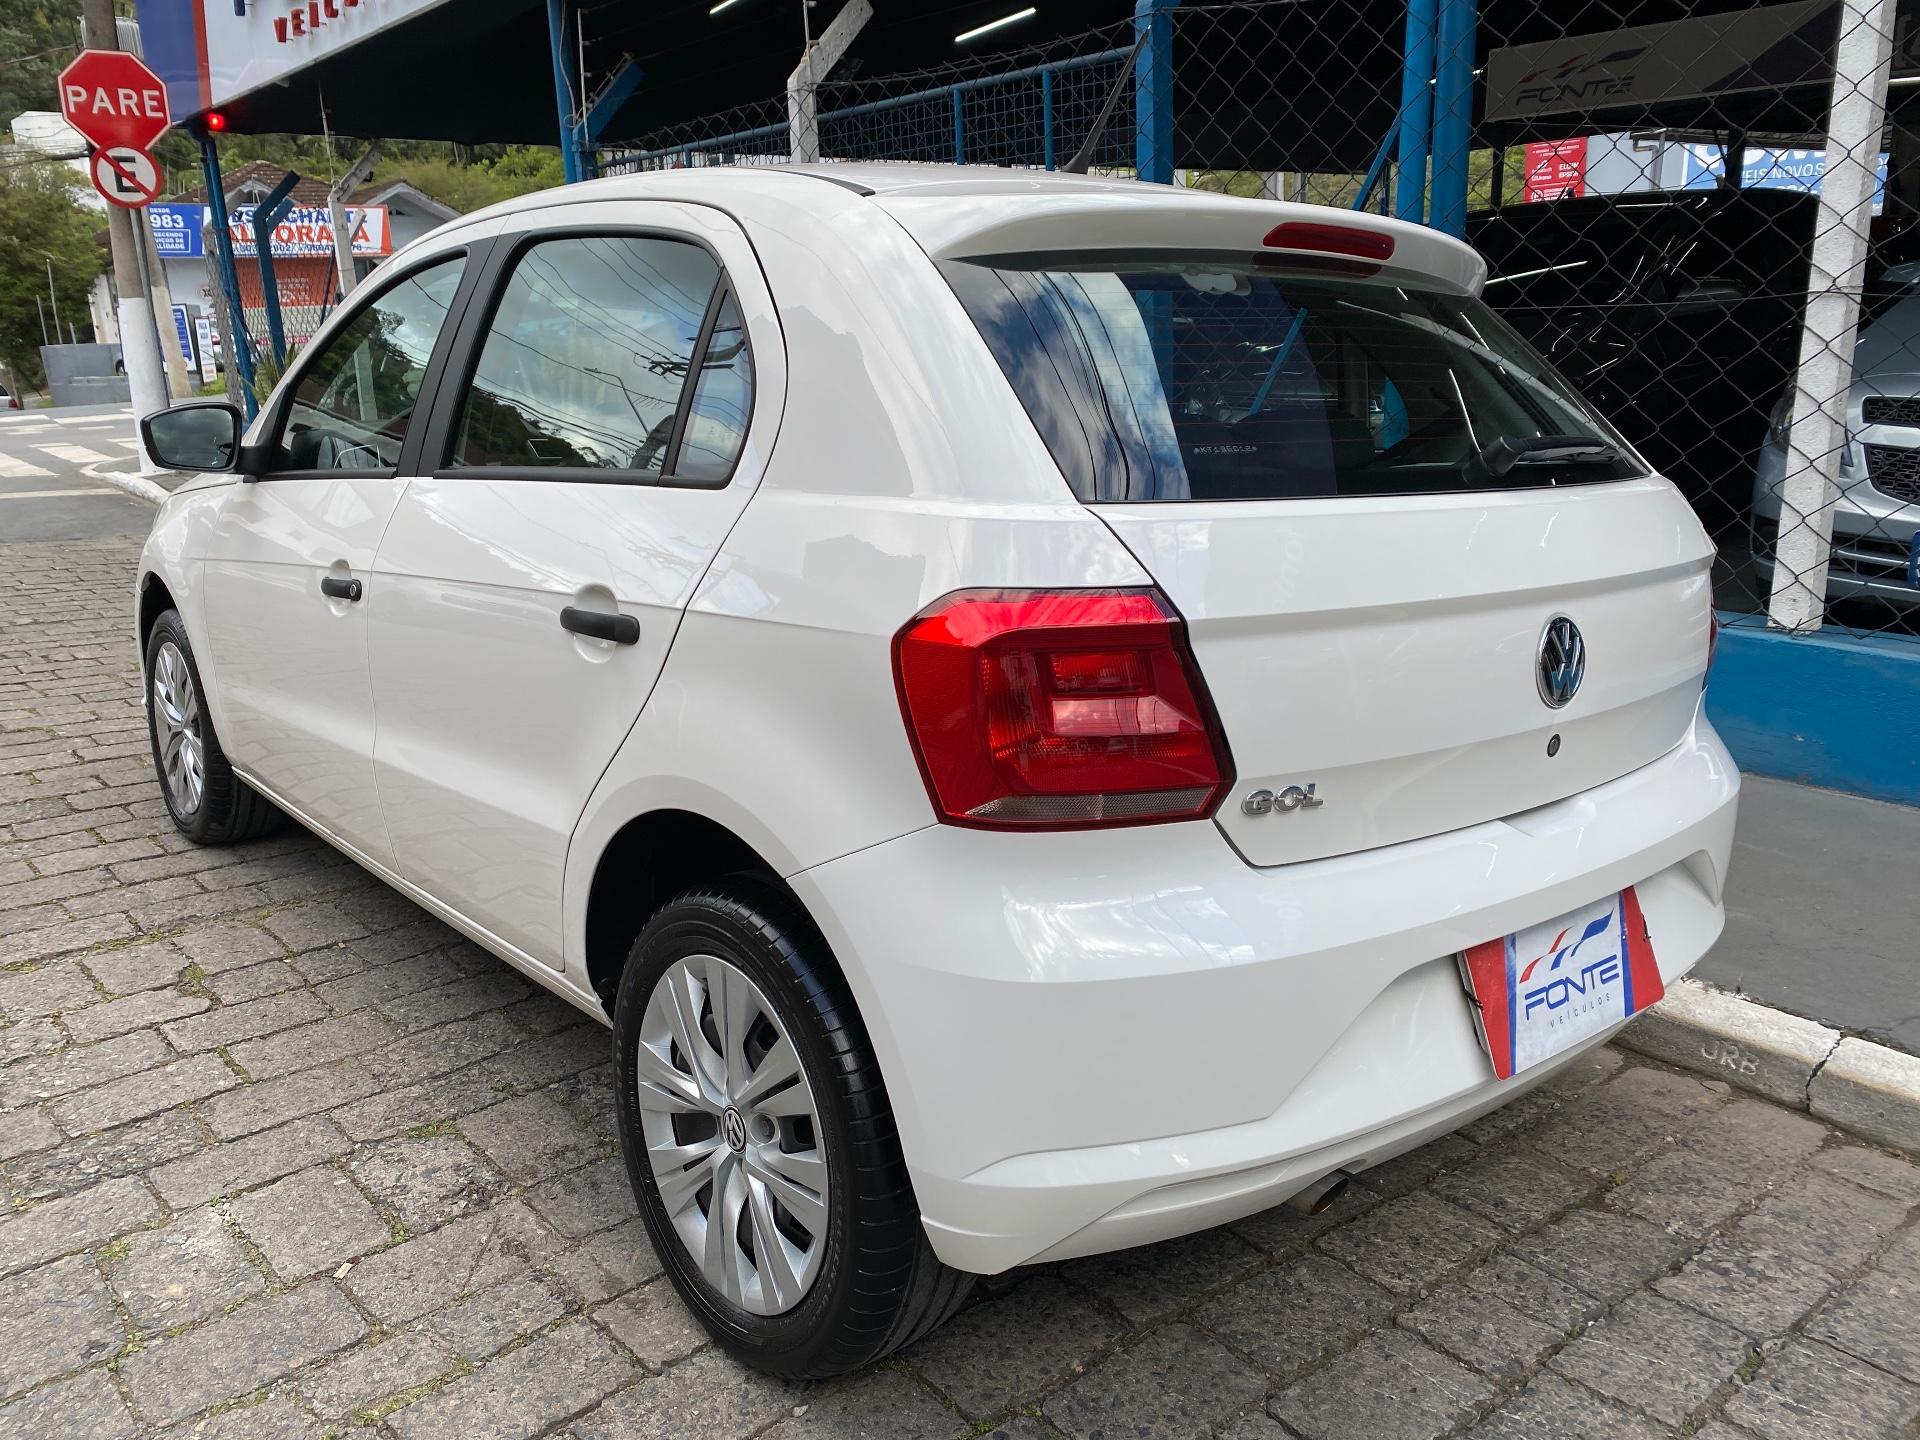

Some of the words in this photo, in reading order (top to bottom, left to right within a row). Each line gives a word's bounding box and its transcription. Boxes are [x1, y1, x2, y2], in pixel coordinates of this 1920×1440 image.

[66, 85, 164, 118] PARE
[1516, 76, 1636, 106] FONTE
[111, 155, 142, 193] E
[1772, 163, 1825, 179] NOVOS
[149, 214, 184, 228] 983
[1241, 783, 1324, 816] GOL
[1524, 954, 1620, 1021] FONTE
